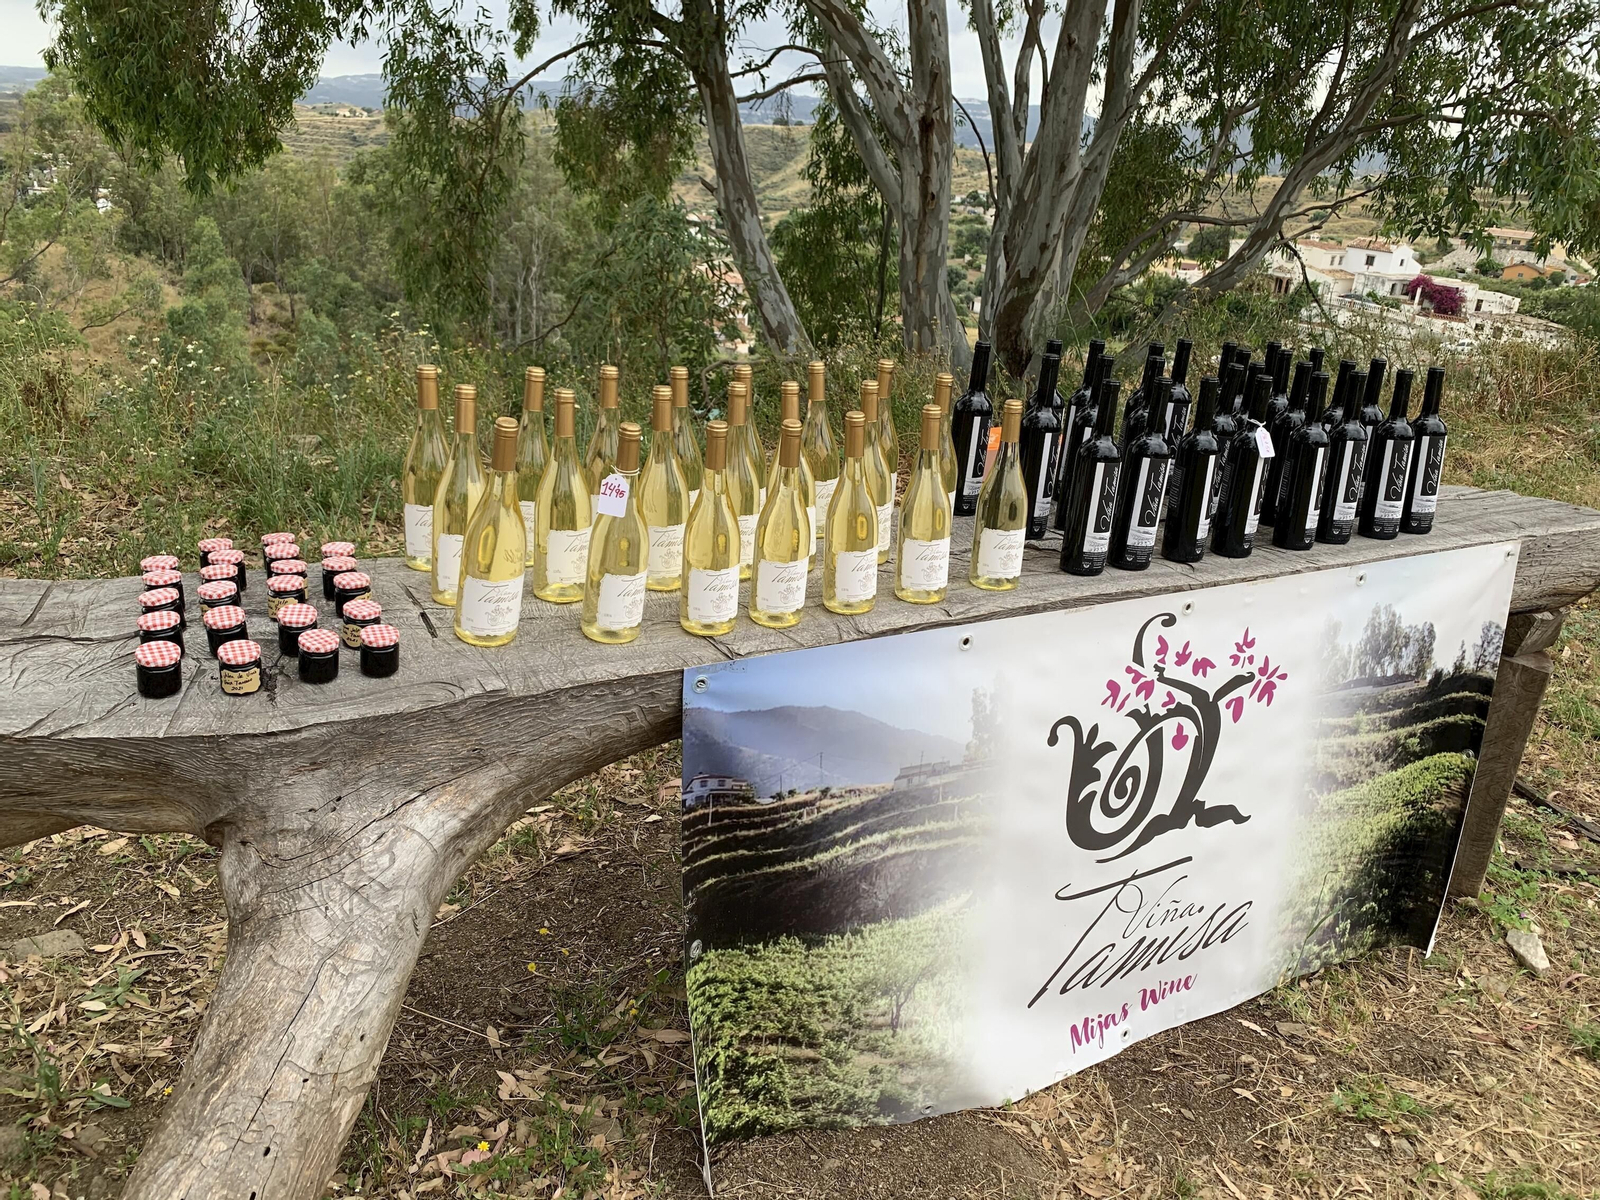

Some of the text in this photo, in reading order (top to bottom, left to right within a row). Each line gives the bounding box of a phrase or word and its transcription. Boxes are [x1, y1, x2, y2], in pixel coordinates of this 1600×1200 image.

[1027, 855, 1254, 1009] Tamisa
[1115, 875, 1197, 940] Viña
[1070, 972, 1198, 1054] Mijas Wine
